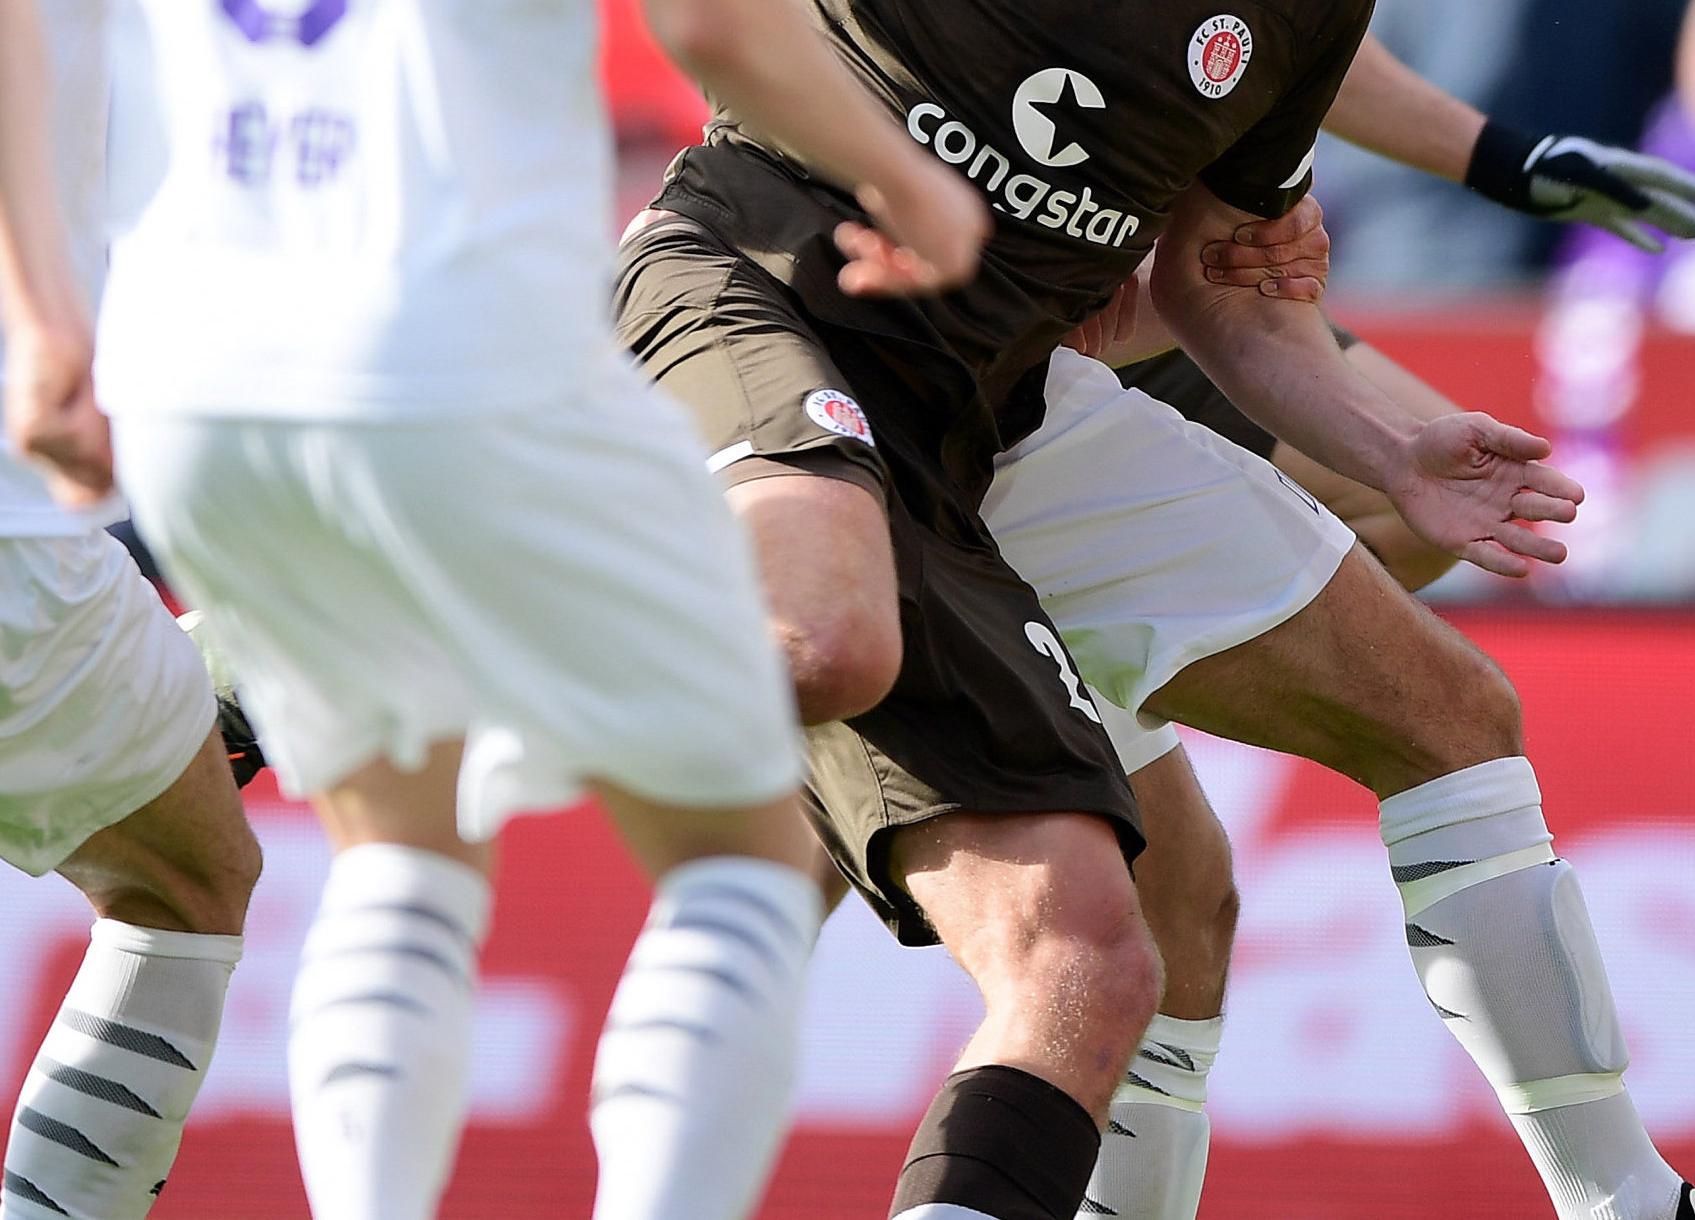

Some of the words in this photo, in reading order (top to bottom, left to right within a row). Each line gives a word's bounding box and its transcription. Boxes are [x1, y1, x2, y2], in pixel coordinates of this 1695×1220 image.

[1196, 28, 1210, 46] FC
[1212, 18, 1229, 32] ST.
[1232, 20, 1250, 64] PAULI
[1199, 77, 1222, 96] 1910
[906, 102, 1140, 248] congstar
